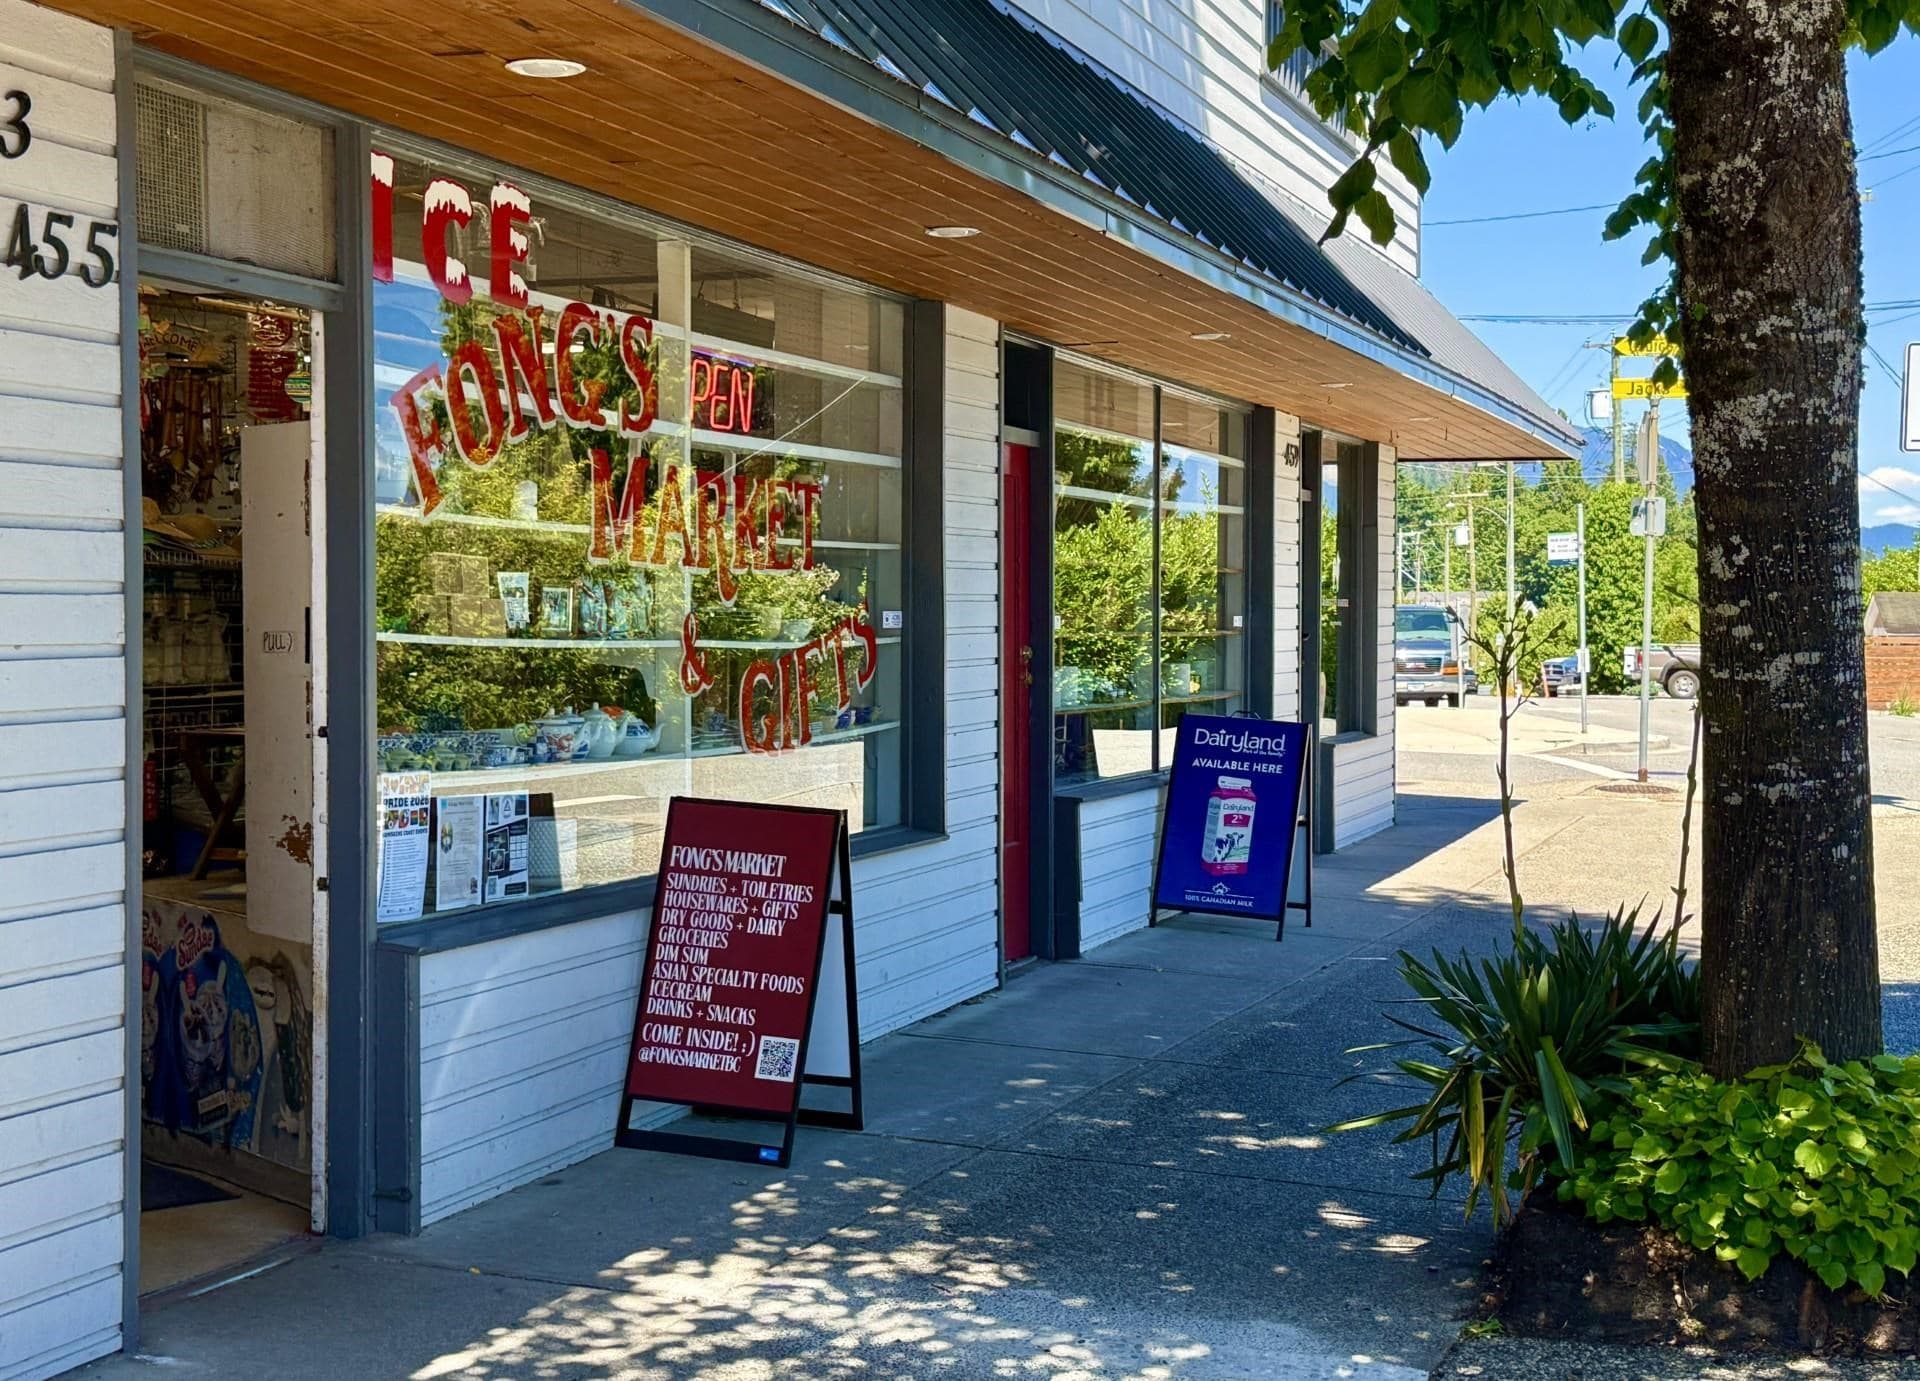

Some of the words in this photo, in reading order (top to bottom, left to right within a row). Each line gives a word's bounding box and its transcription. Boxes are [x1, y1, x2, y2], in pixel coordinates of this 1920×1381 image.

[371, 151, 531, 309] ICE
[6, 203, 118, 288] 455
[689, 358, 753, 433] PEN
[389, 302, 655, 520] FONG'S
[588, 448, 822, 607] MARKET
[680, 612, 714, 697] &
[740, 598, 877, 757] GIFTS
[1194, 728, 1286, 753] Dairyland
[1192, 757, 1250, 771] AVAILABLE
[1252, 763, 1283, 774] HERE
[383, 797, 409, 809] PRIDE
[669, 845, 724, 872] FONG'S
[724, 850, 787, 877] MARKET
[666, 872, 728, 894] SUNDRIES
[741, 880, 814, 903] TOILETRIES
[1201, 896, 1236, 905] CANADIAN
[663, 890, 749, 914] HOUSEWARES
[762, 900, 800, 920] GIFTS
[658, 925, 729, 949] GROCERIES
[660, 908, 688, 926] DRY
[690, 912, 734, 932] GOODS
[746, 917, 787, 936] DAIRY
[655, 943, 678, 962] DIM
[681, 946, 710, 965] SUM
[649, 979, 713, 1002] ICECREAM
[652, 961, 689, 981] ASIAN
[690, 965, 758, 990] SPECIALTY
[760, 973, 805, 995] FOODS
[646, 997, 694, 1019] DRINKS
[706, 1004, 756, 1026] SNACKS
[642, 1022, 684, 1046] COME
[687, 1028, 739, 1052] INSIDE!
[638, 1046, 742, 1072] @FONGSMARKETBC
